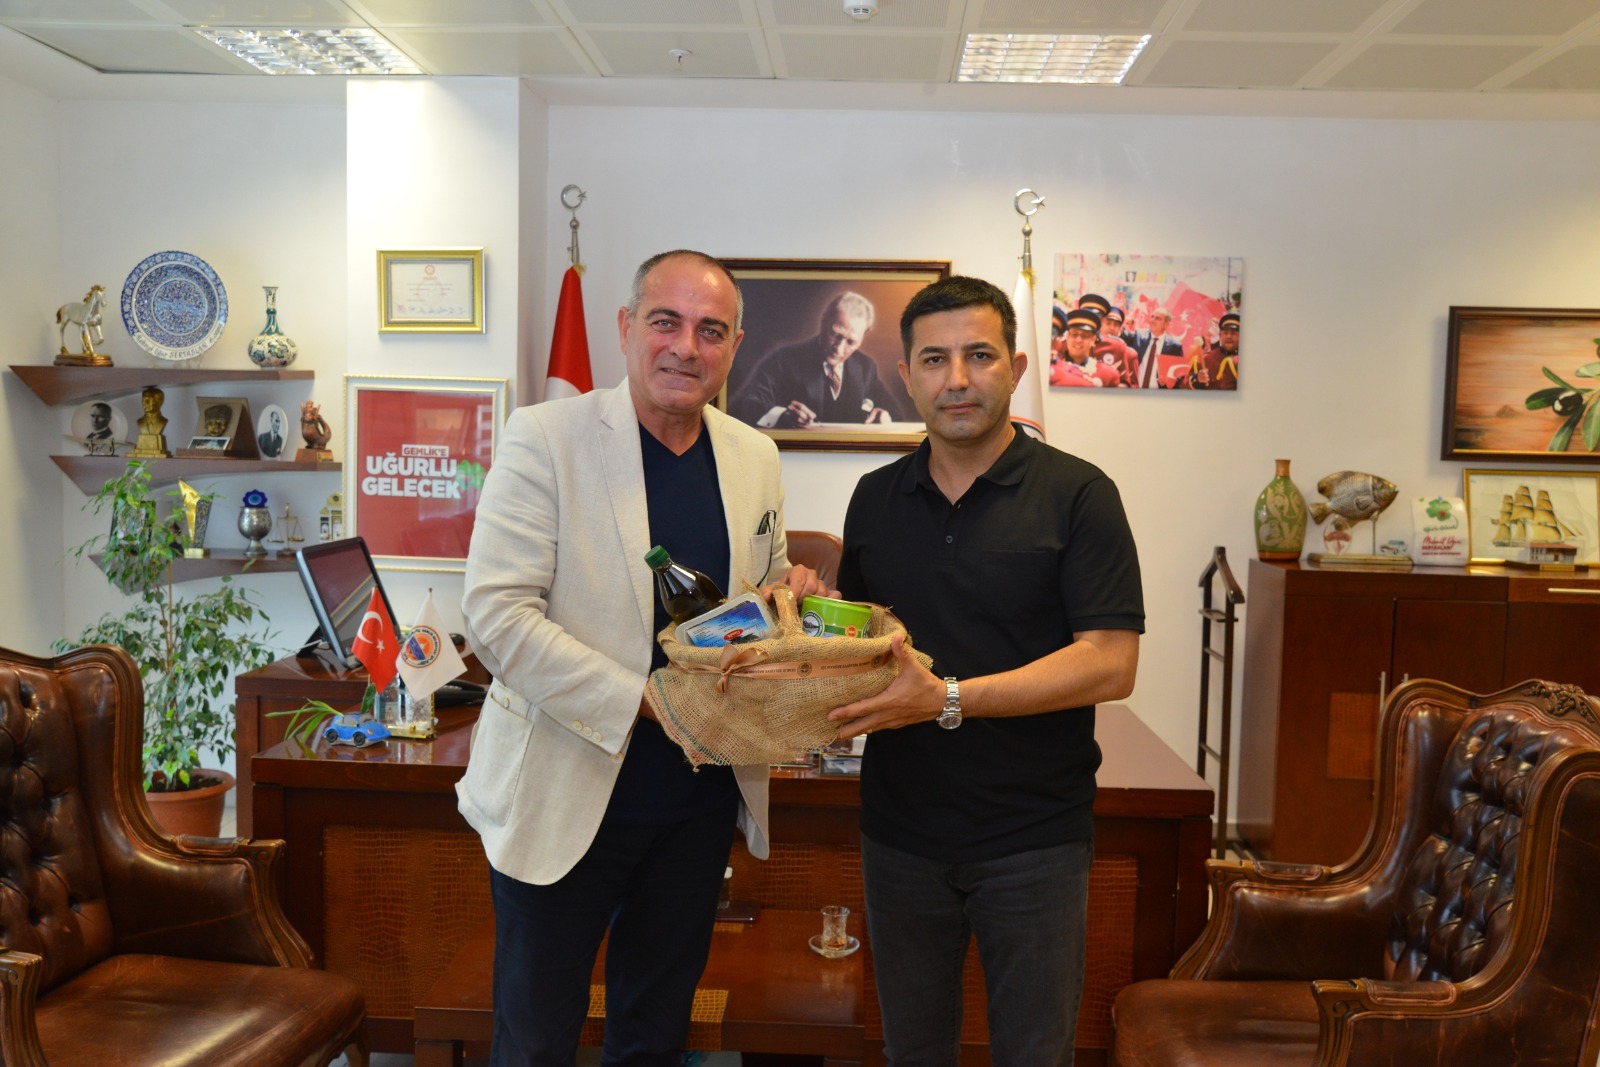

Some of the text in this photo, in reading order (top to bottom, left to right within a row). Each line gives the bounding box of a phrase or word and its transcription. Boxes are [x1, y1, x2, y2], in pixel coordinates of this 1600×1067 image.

[404, 446, 447, 456] GEMLİK'E
[366, 452, 457, 478] UĞURLU
[361, 476, 461, 499] GELECEK
